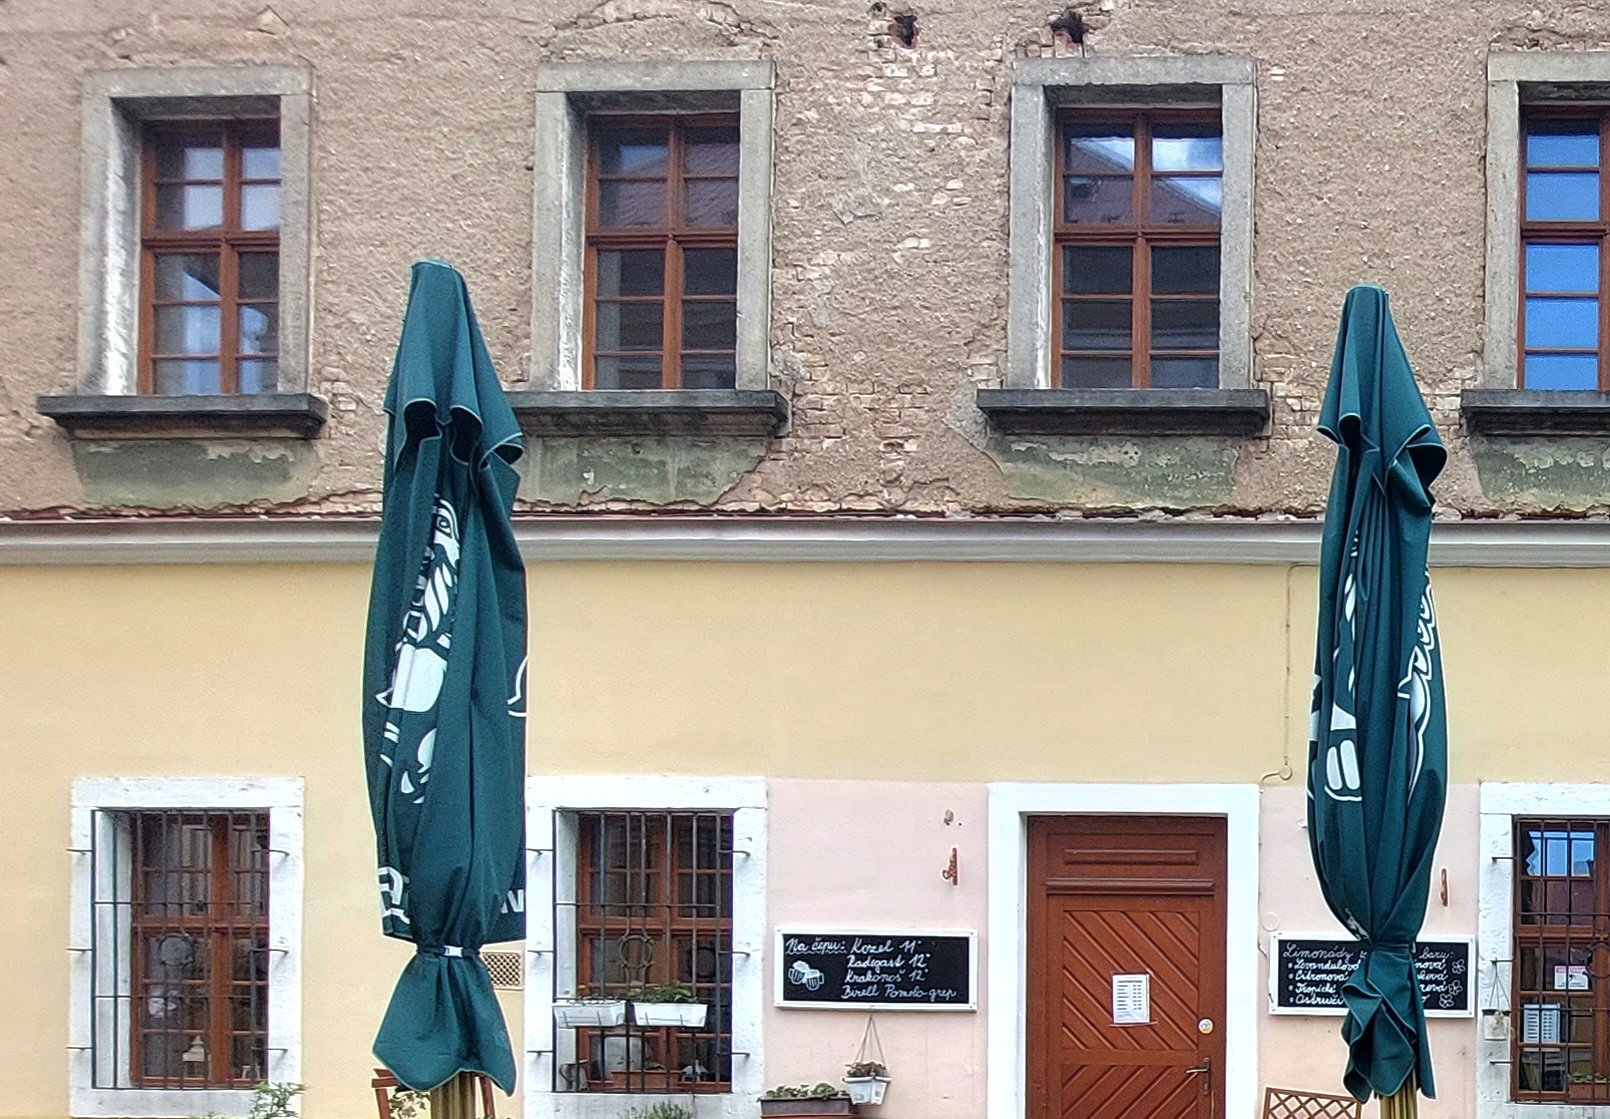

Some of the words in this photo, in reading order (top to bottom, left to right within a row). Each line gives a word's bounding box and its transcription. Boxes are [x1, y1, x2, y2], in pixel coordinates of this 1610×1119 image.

[785, 937, 809, 952] Na
[811, 936, 846, 955] čepu:
[850, 937, 894, 954] Kozel
[1283, 942, 1353, 964] Limonády
[847, 954, 905, 973] Radegast
[844, 969, 906, 983] Krakonoš
[841, 984, 880, 999] Birell
